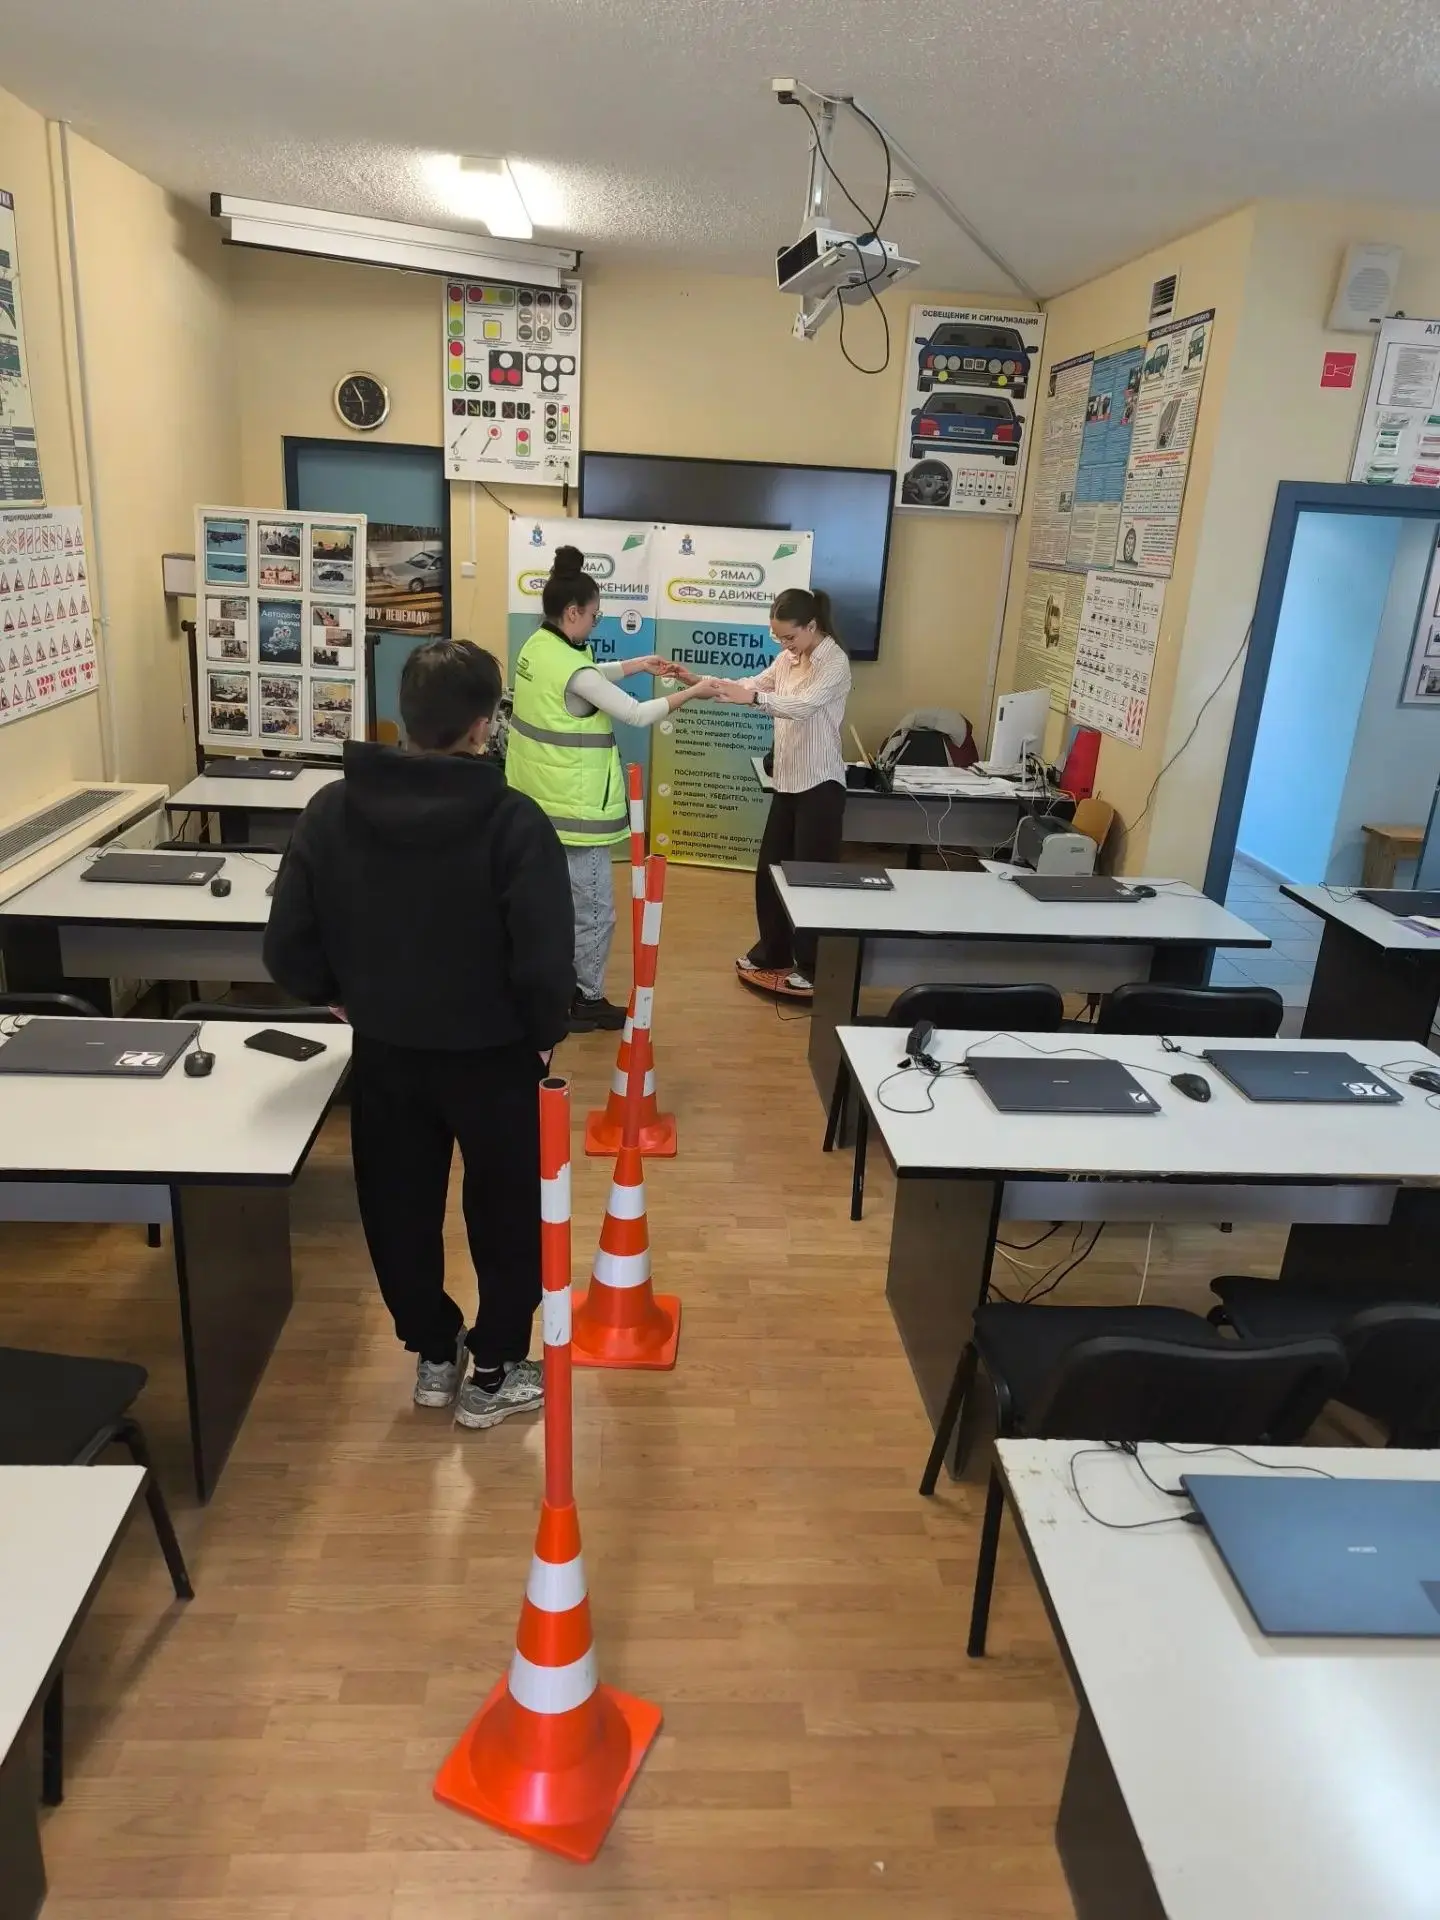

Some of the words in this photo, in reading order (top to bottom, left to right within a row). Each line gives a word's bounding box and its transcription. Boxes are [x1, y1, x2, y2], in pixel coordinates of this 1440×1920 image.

[922, 309, 969, 321] ОСВЕЩЕНИЕ
[979, 314, 1039, 326] СИГНАЛИЗАЦИЯ
[583, 562, 605, 572] МАЛ
[720, 570, 755, 581] ЯМАЛ
[708, 589, 716, 598] В
[718, 590, 776, 601] ДВИЖЕН
[692, 630, 764, 648] СОВЕТЫ
[674, 769, 720, 779] ПОСМОТРИТЕ
